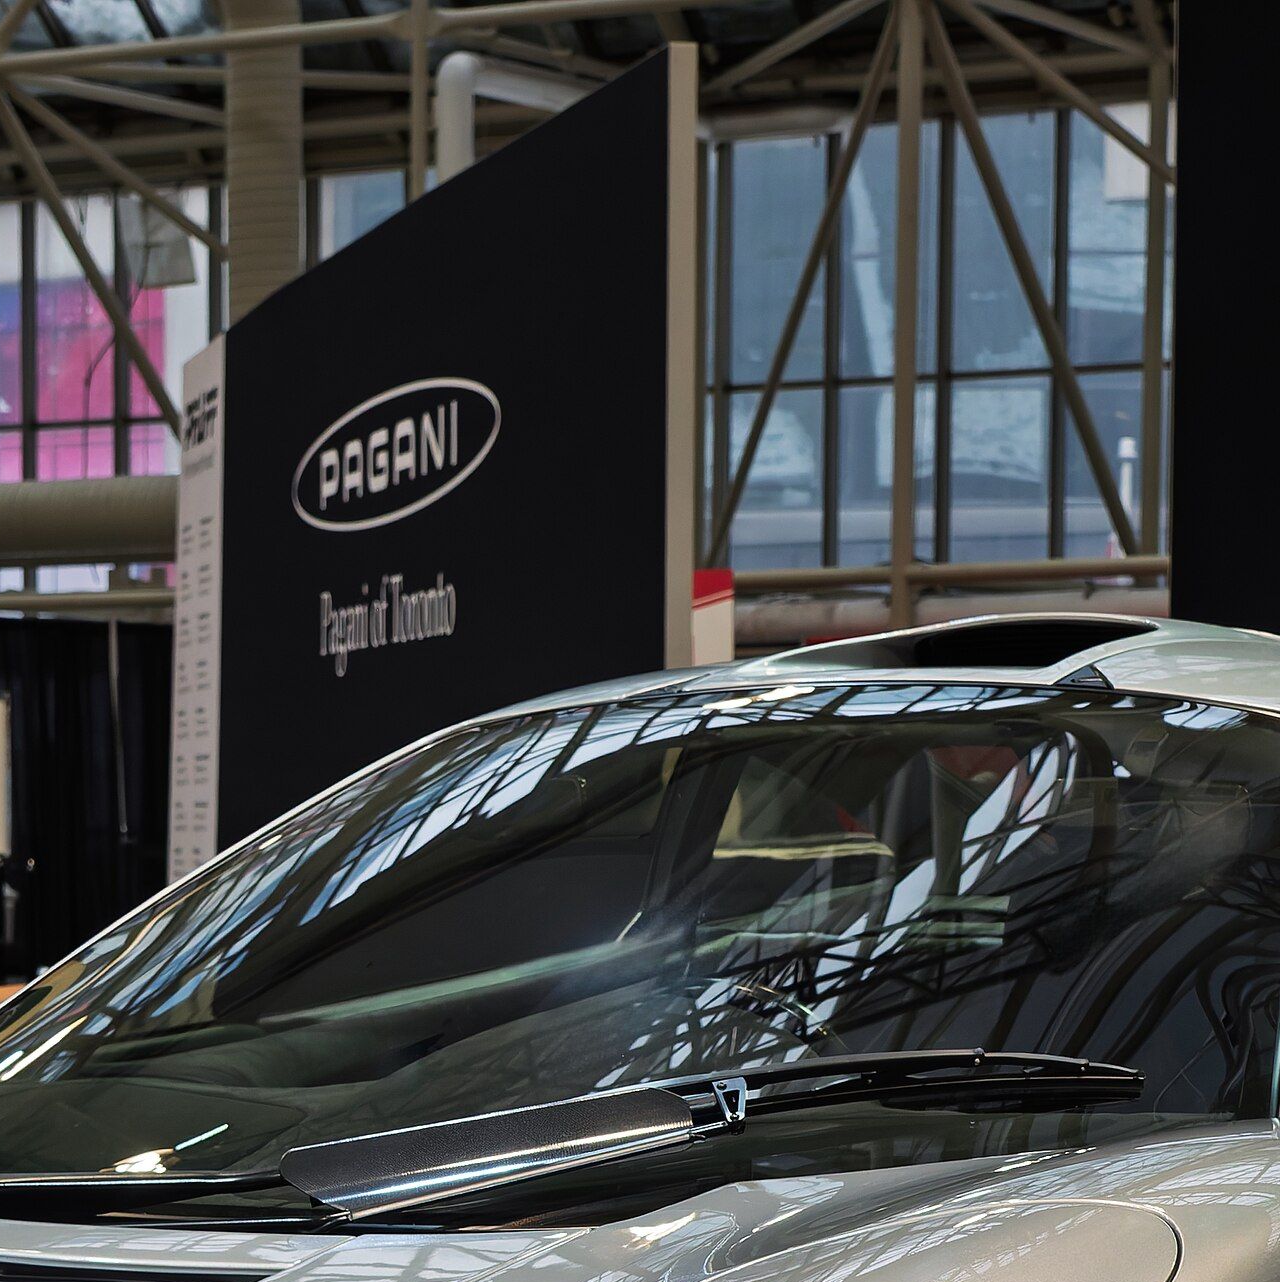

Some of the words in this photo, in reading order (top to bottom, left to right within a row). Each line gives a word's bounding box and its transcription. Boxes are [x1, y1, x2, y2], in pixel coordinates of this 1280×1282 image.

[319, 399, 459, 511] PAGANI
[319, 582, 369, 677] Pagani
[369, 573, 389, 648] of
[389, 571, 457, 644] Toronto
